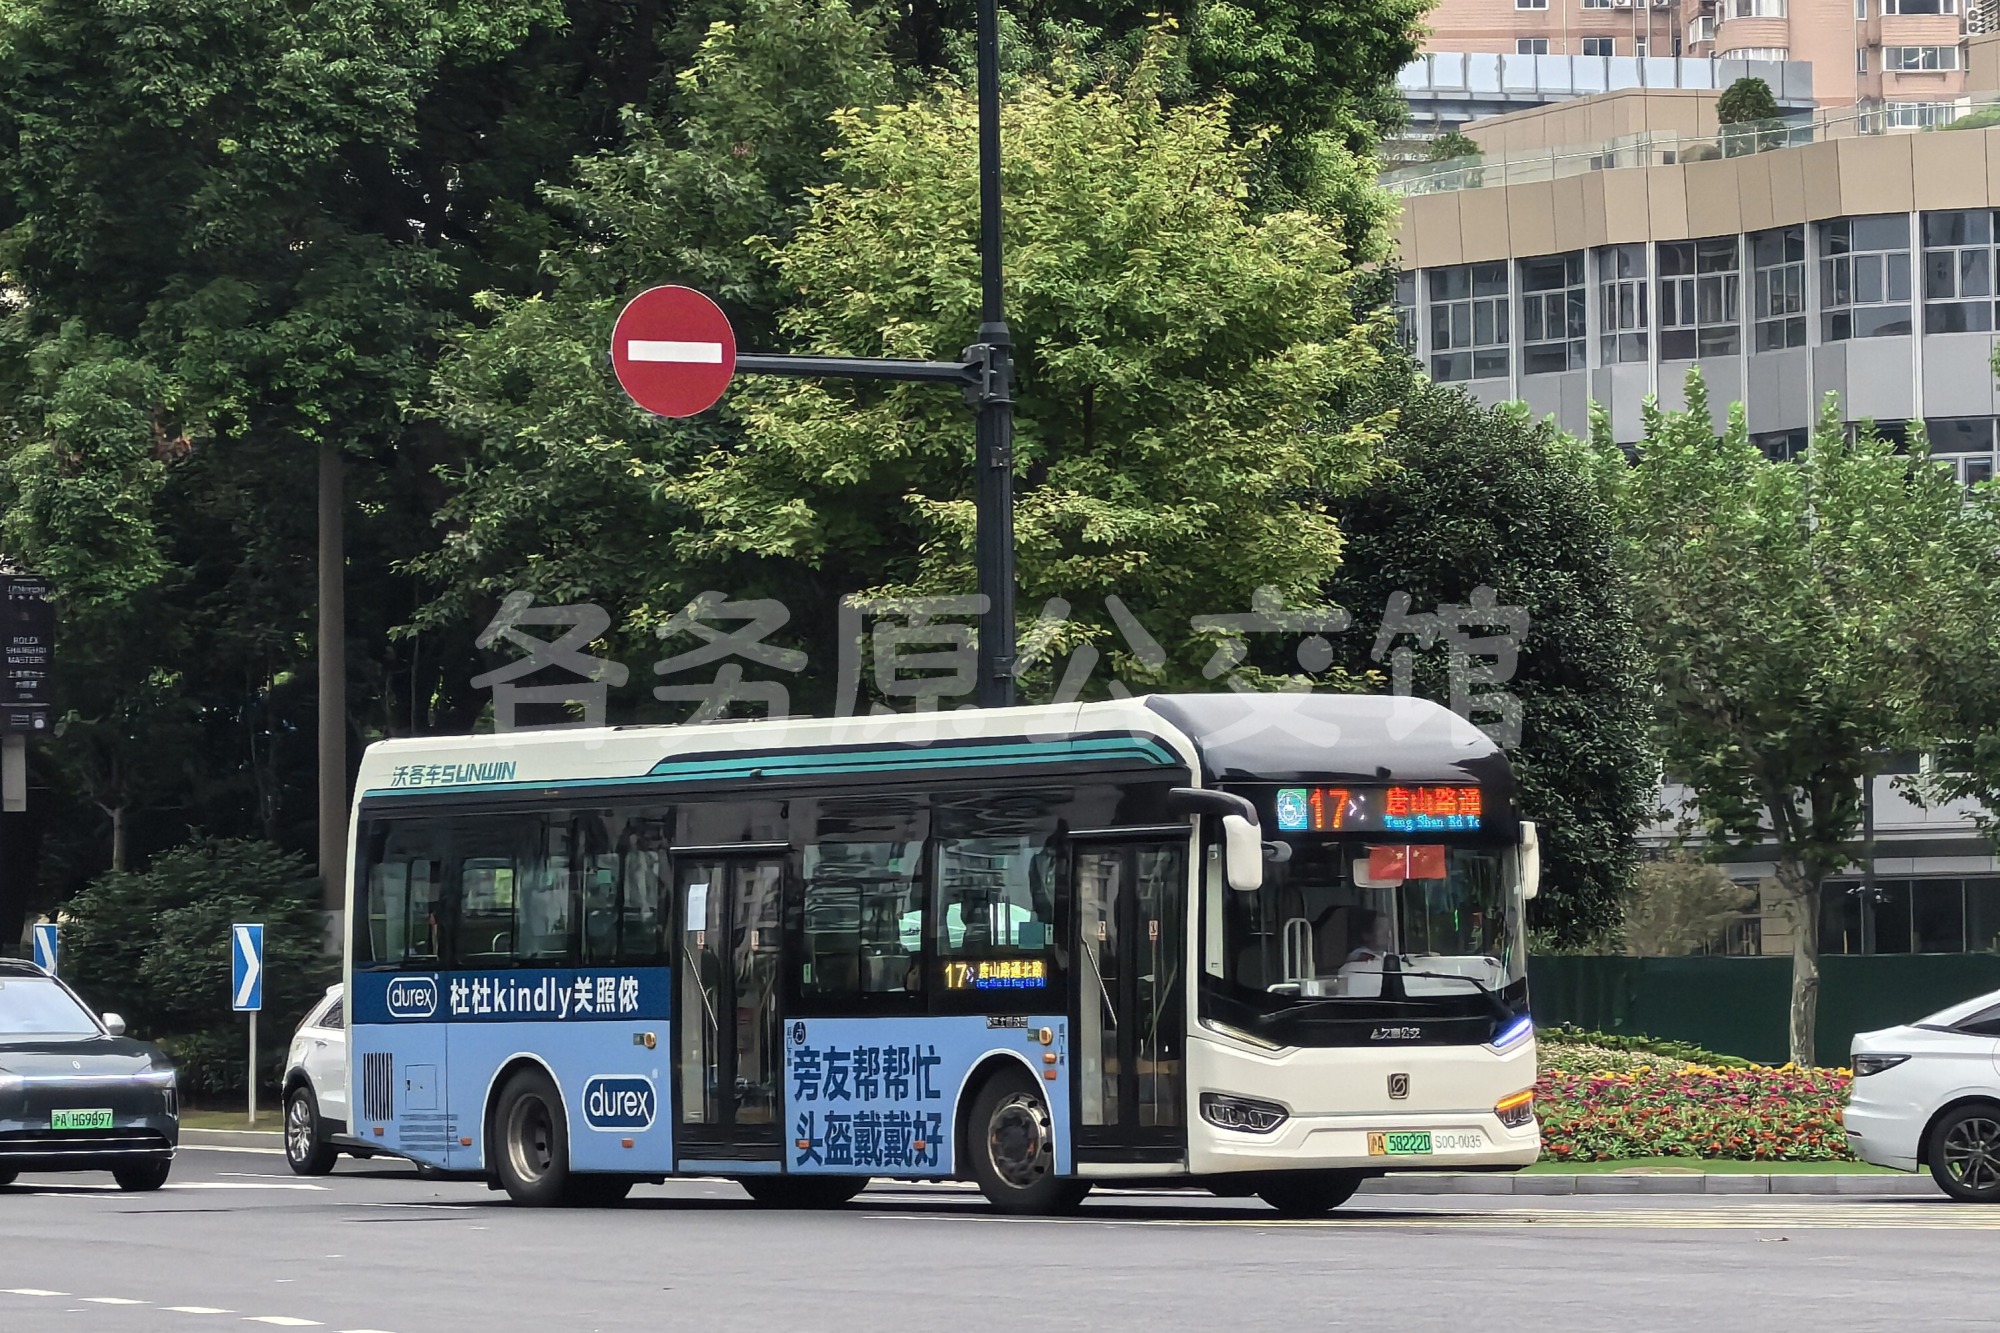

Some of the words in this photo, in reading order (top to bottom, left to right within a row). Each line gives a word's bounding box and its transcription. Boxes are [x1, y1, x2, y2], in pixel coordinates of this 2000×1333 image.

[13, 636, 39, 645] ROLEX
[8, 656, 45, 664] MASTERS
[1309, 788, 1348, 829] 17
[1385, 787, 1482, 815] 唐山路通
[945, 963, 967, 988] 17
[979, 961, 1043, 979] 唐山路通北路
[391, 983, 434, 1012] durex
[793, 1044, 942, 1102] 旁友帮帮忙
[589, 1082, 652, 1124] durex
[796, 1110, 943, 1167] 头盔戴戴好
